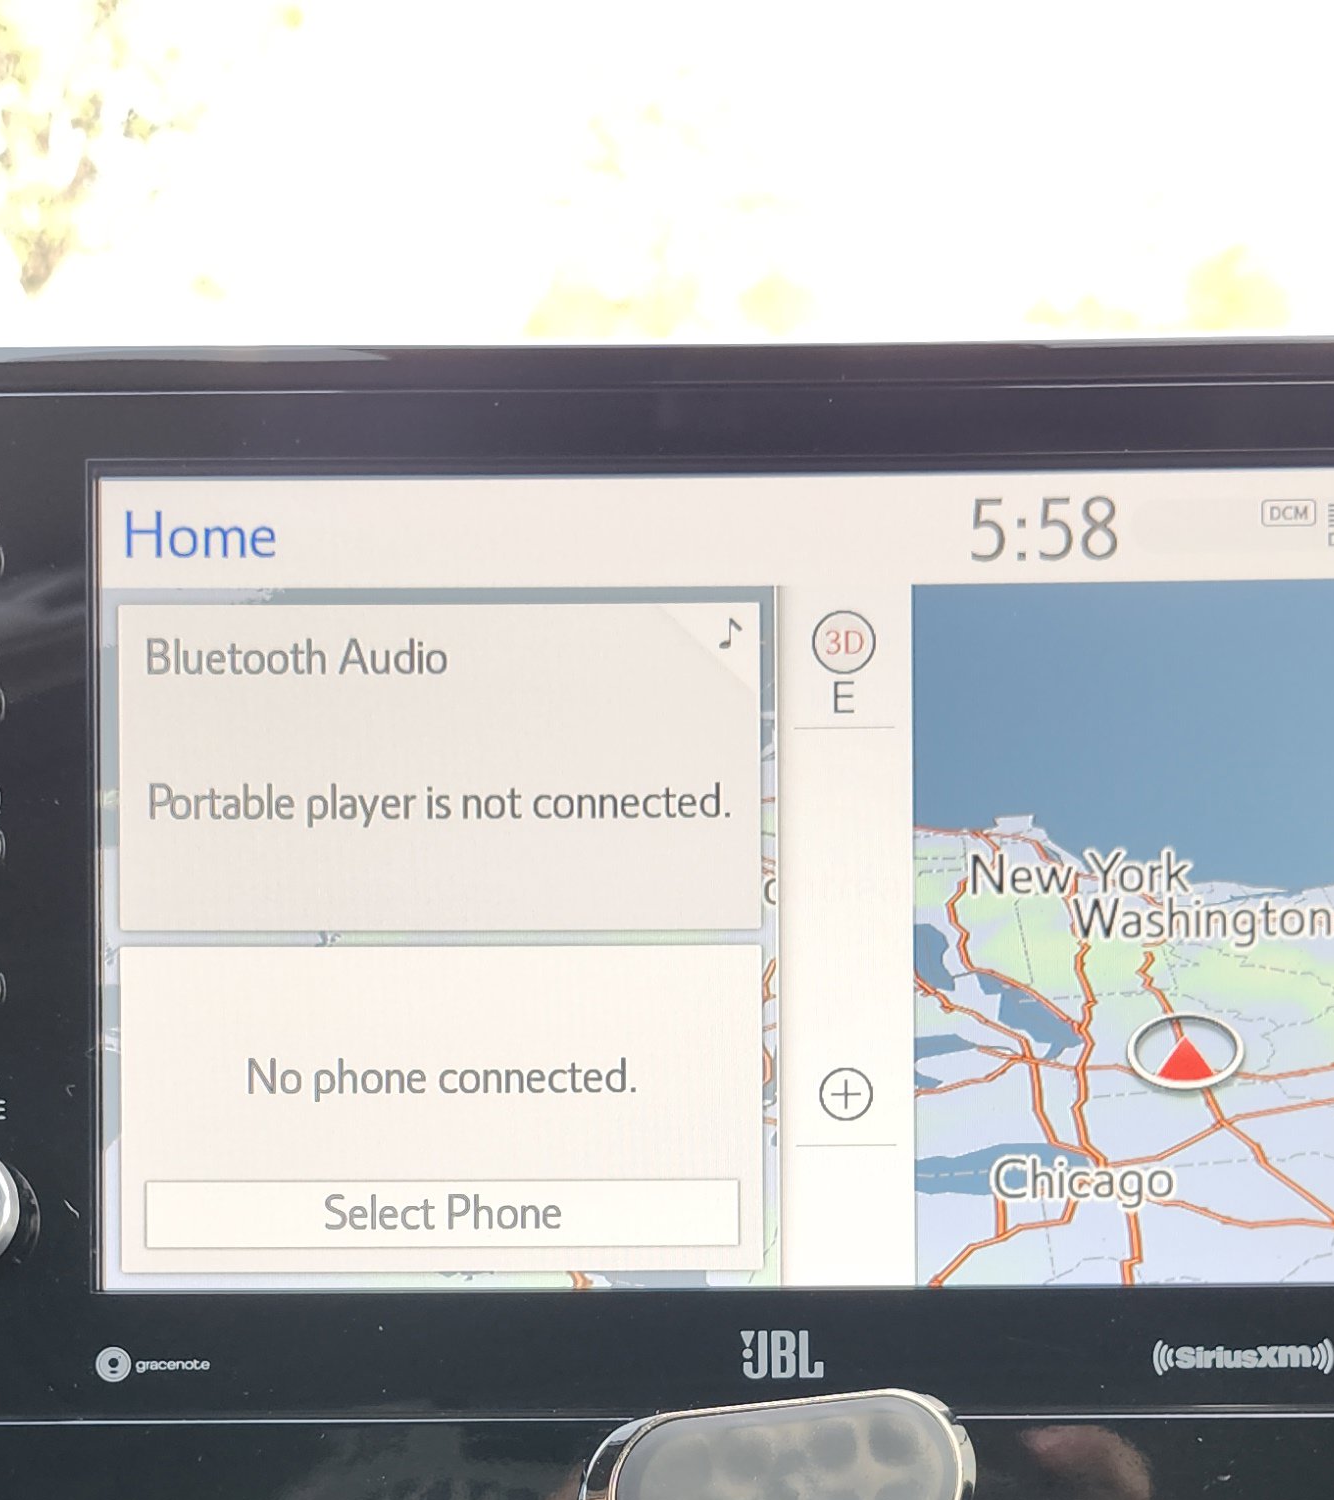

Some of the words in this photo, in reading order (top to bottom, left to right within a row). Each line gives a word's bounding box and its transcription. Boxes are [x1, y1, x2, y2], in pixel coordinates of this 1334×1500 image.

[123, 510, 277, 561] Home
[969, 495, 1119, 563] 5:58
[1268, 503, 1309, 525] DCM
[144, 638, 328, 677] Bluetooth
[338, 638, 449, 677] Audio
[825, 629, 865, 657] 3D
[832, 681, 855, 715] E
[148, 783, 296, 822] Portable
[306, 783, 416, 827] player
[425, 785, 453, 820] is
[461, 787, 522, 820] not
[531, 781, 733, 820] connected.
[968, 854, 1071, 896] New
[1082, 850, 1191, 895] York
[1071, 896, 1333, 949] Washington
[246, 1058, 303, 1096] No
[312, 1056, 428, 1103] phone
[437, 1055, 638, 1095] connected.
[991, 1158, 1175, 1208] Chicago
[324, 1193, 436, 1233] Select
[446, 1194, 563, 1233] Phone
[135, 1357, 211, 1375] gracenote
[741, 1330, 825, 1380] JBL
